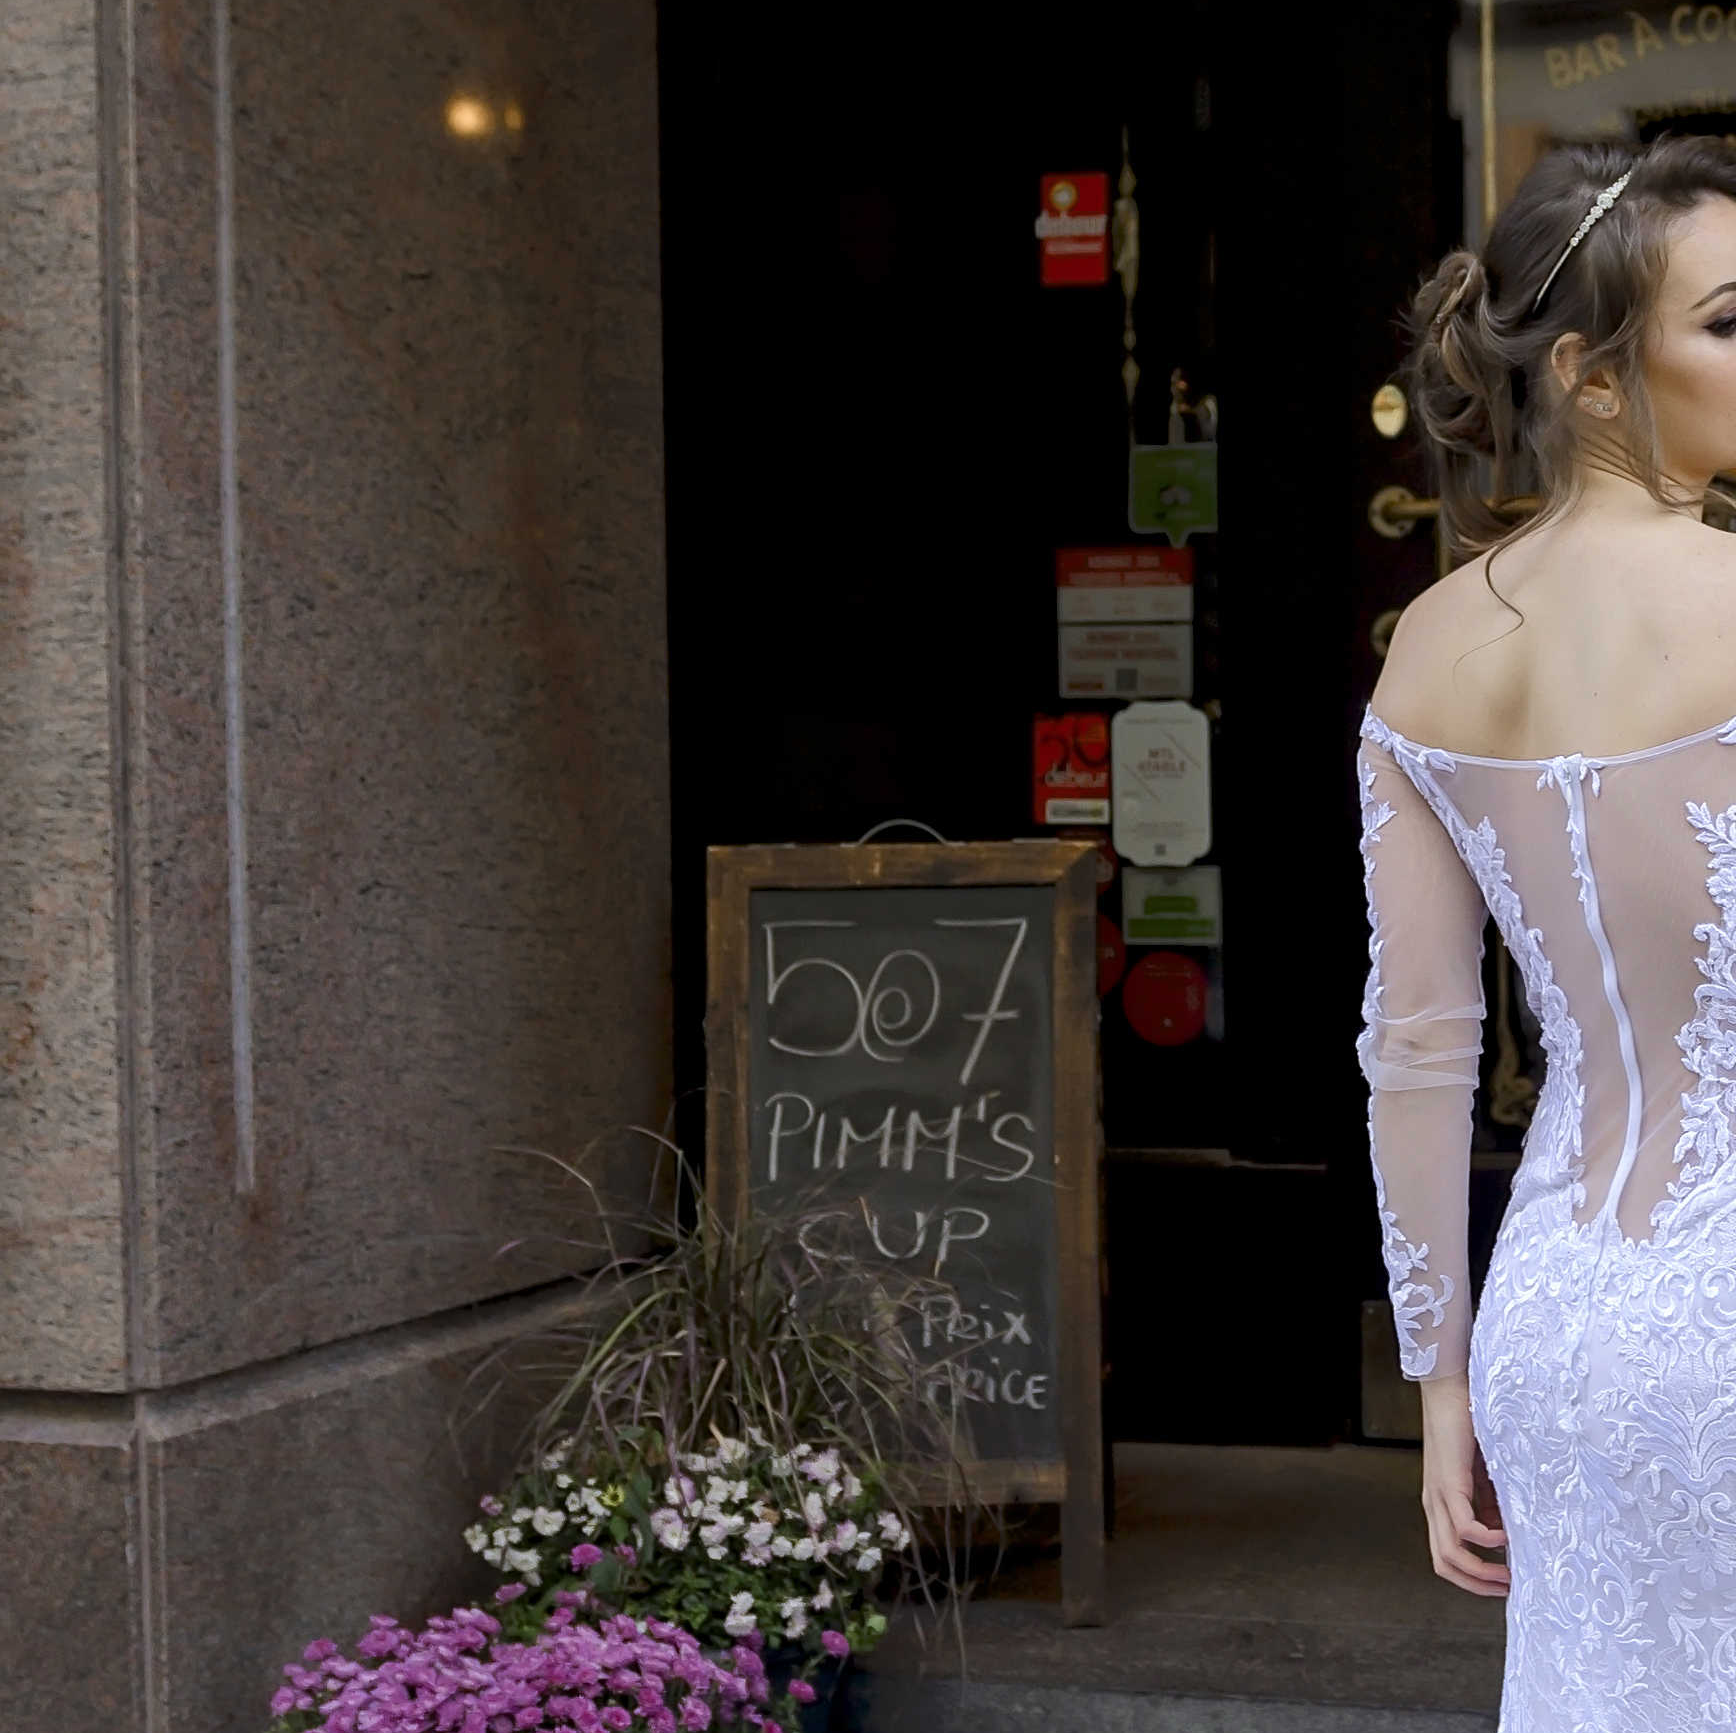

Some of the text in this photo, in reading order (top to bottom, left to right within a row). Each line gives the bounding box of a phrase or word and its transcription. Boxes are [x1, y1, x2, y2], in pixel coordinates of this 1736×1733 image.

[1545, 31, 1627, 91] BAR
[764, 1092, 1036, 1182] PIMM'S
[798, 1206, 991, 1264] CUP
